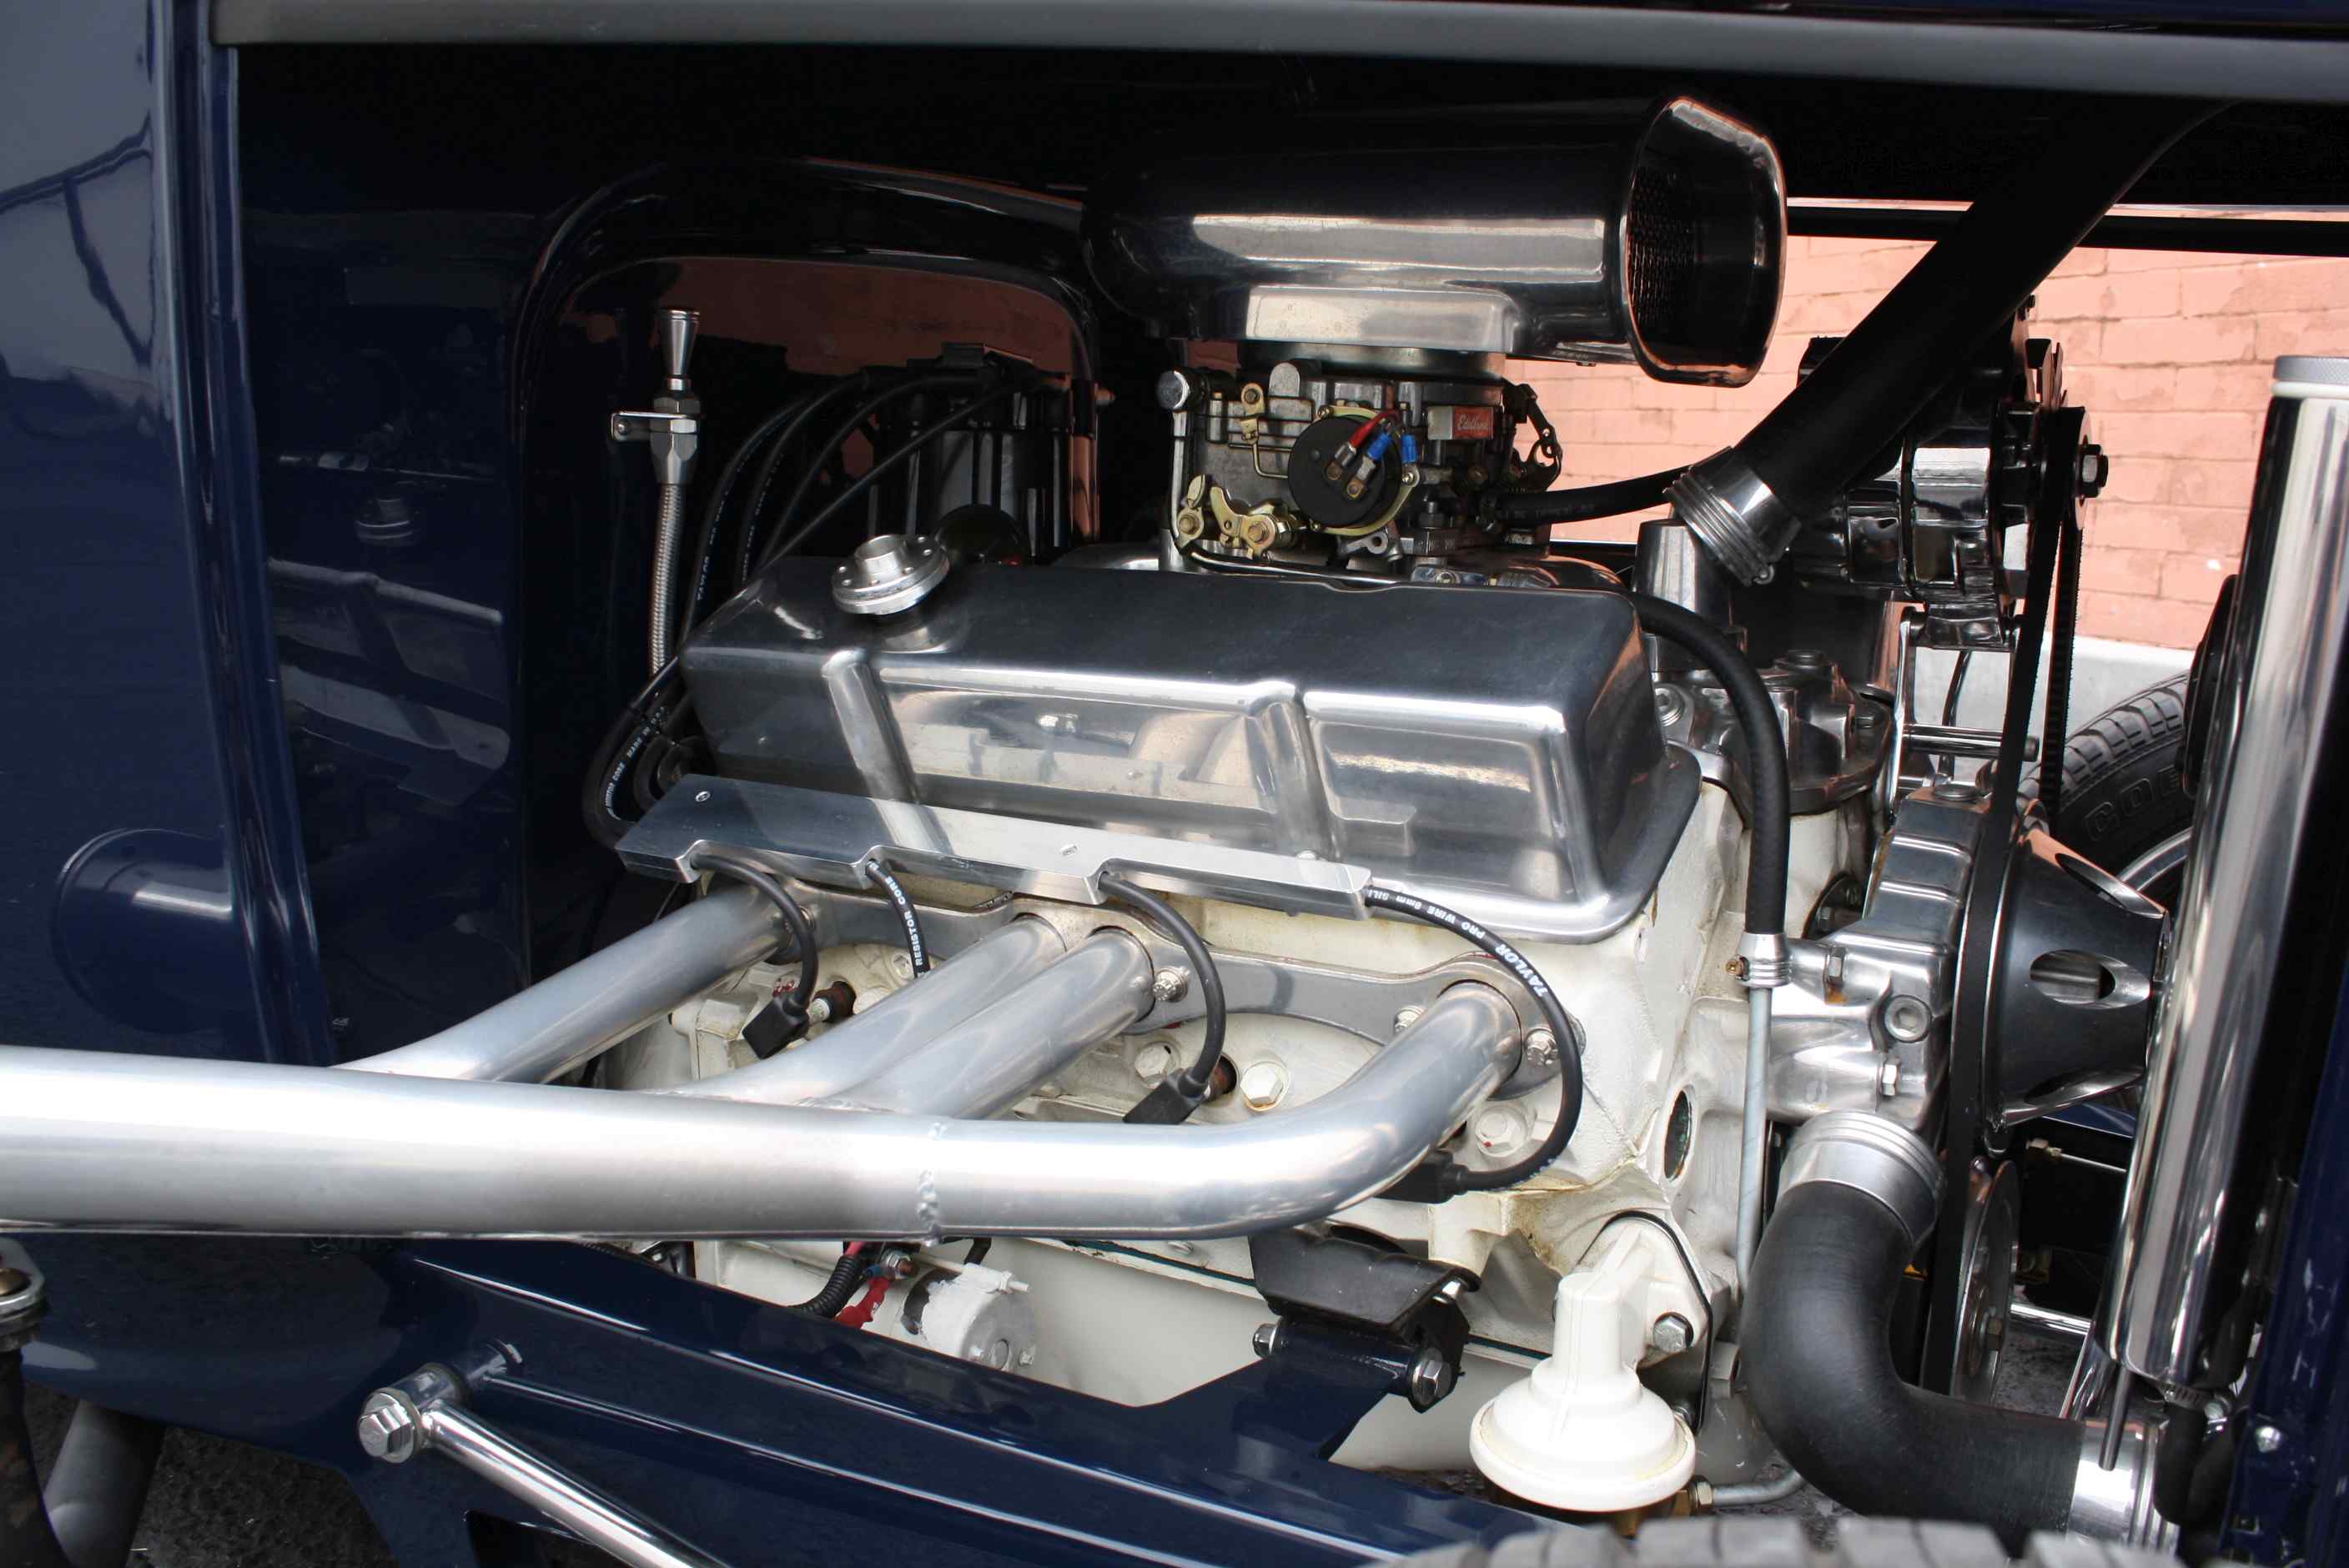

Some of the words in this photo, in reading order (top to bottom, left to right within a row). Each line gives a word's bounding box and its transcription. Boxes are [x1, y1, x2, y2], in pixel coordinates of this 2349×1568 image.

[885, 876, 906, 905] CORE
[1426, 906, 1456, 925] WIRE
[903, 910, 923, 966] RESISTOR
[1461, 922, 1486, 940] PRO
[1495, 943, 1548, 997] TAYLOR
